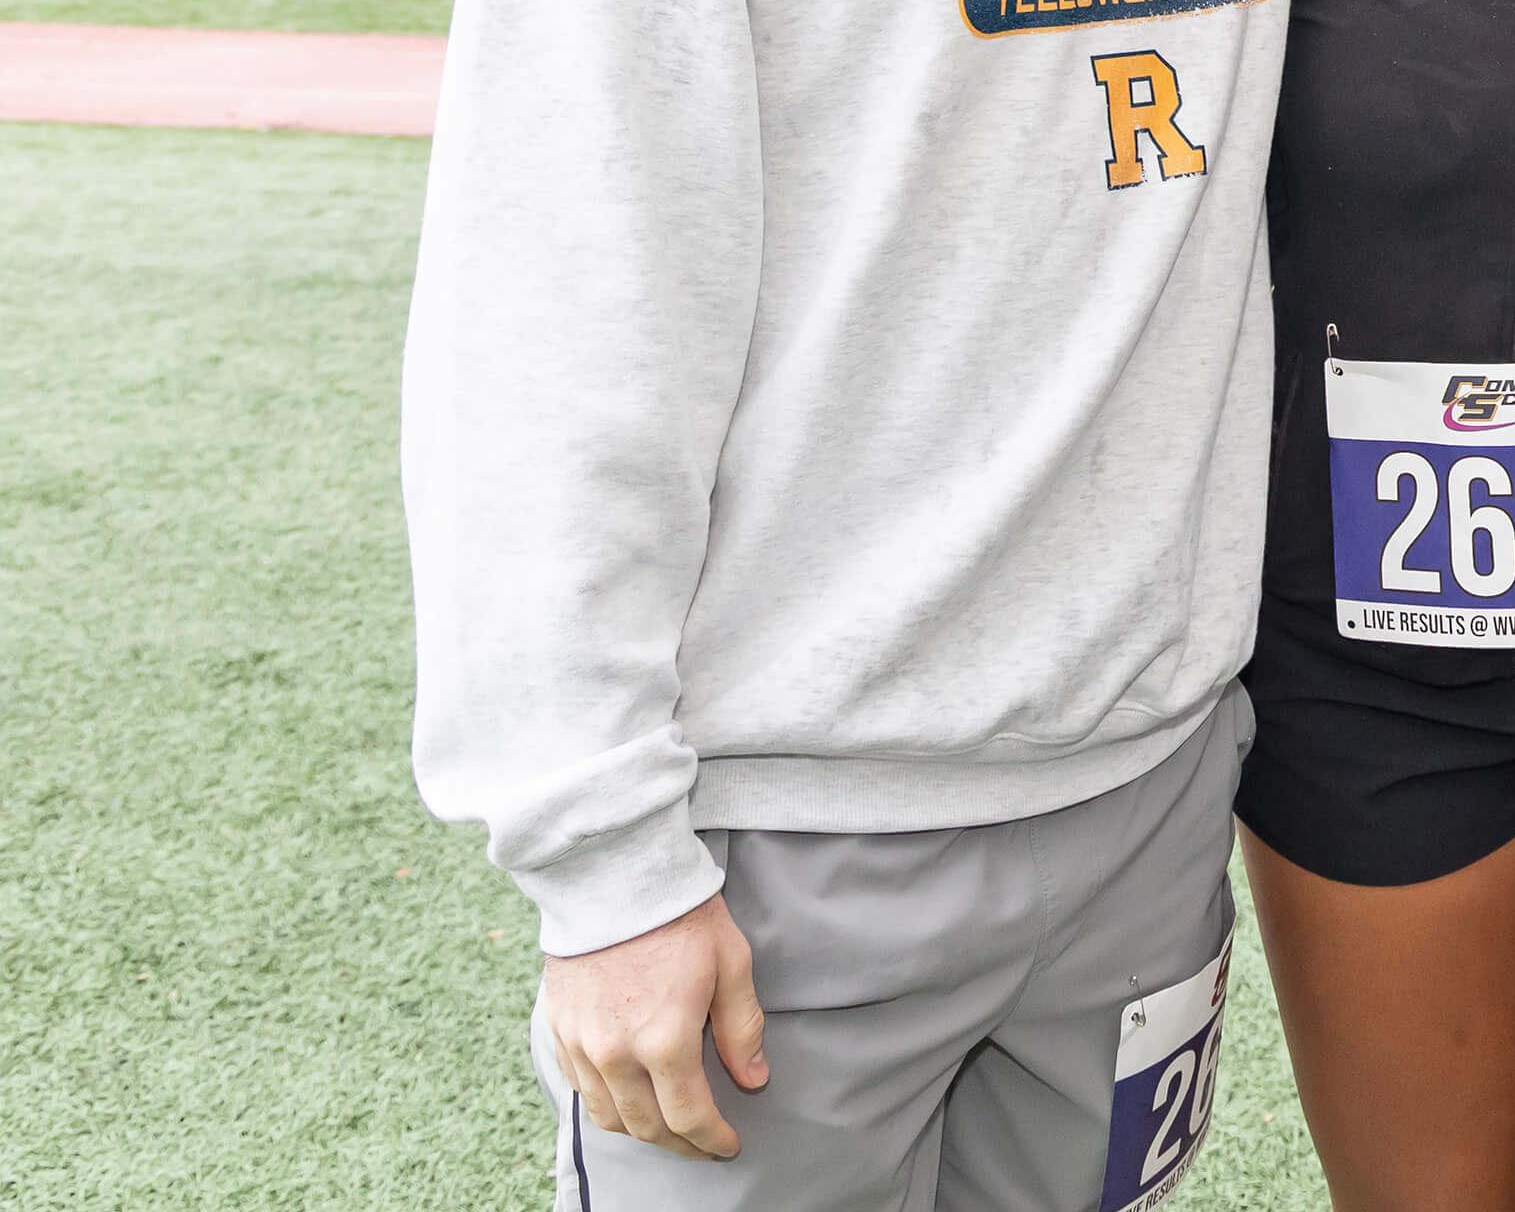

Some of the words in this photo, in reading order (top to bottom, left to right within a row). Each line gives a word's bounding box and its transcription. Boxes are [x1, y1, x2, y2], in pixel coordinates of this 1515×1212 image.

[1090, 48, 1208, 191] R
[1363, 608, 1396, 630] LIVE
[1400, 610, 1465, 636] RESULTS
[1470, 614, 1489, 638] @
